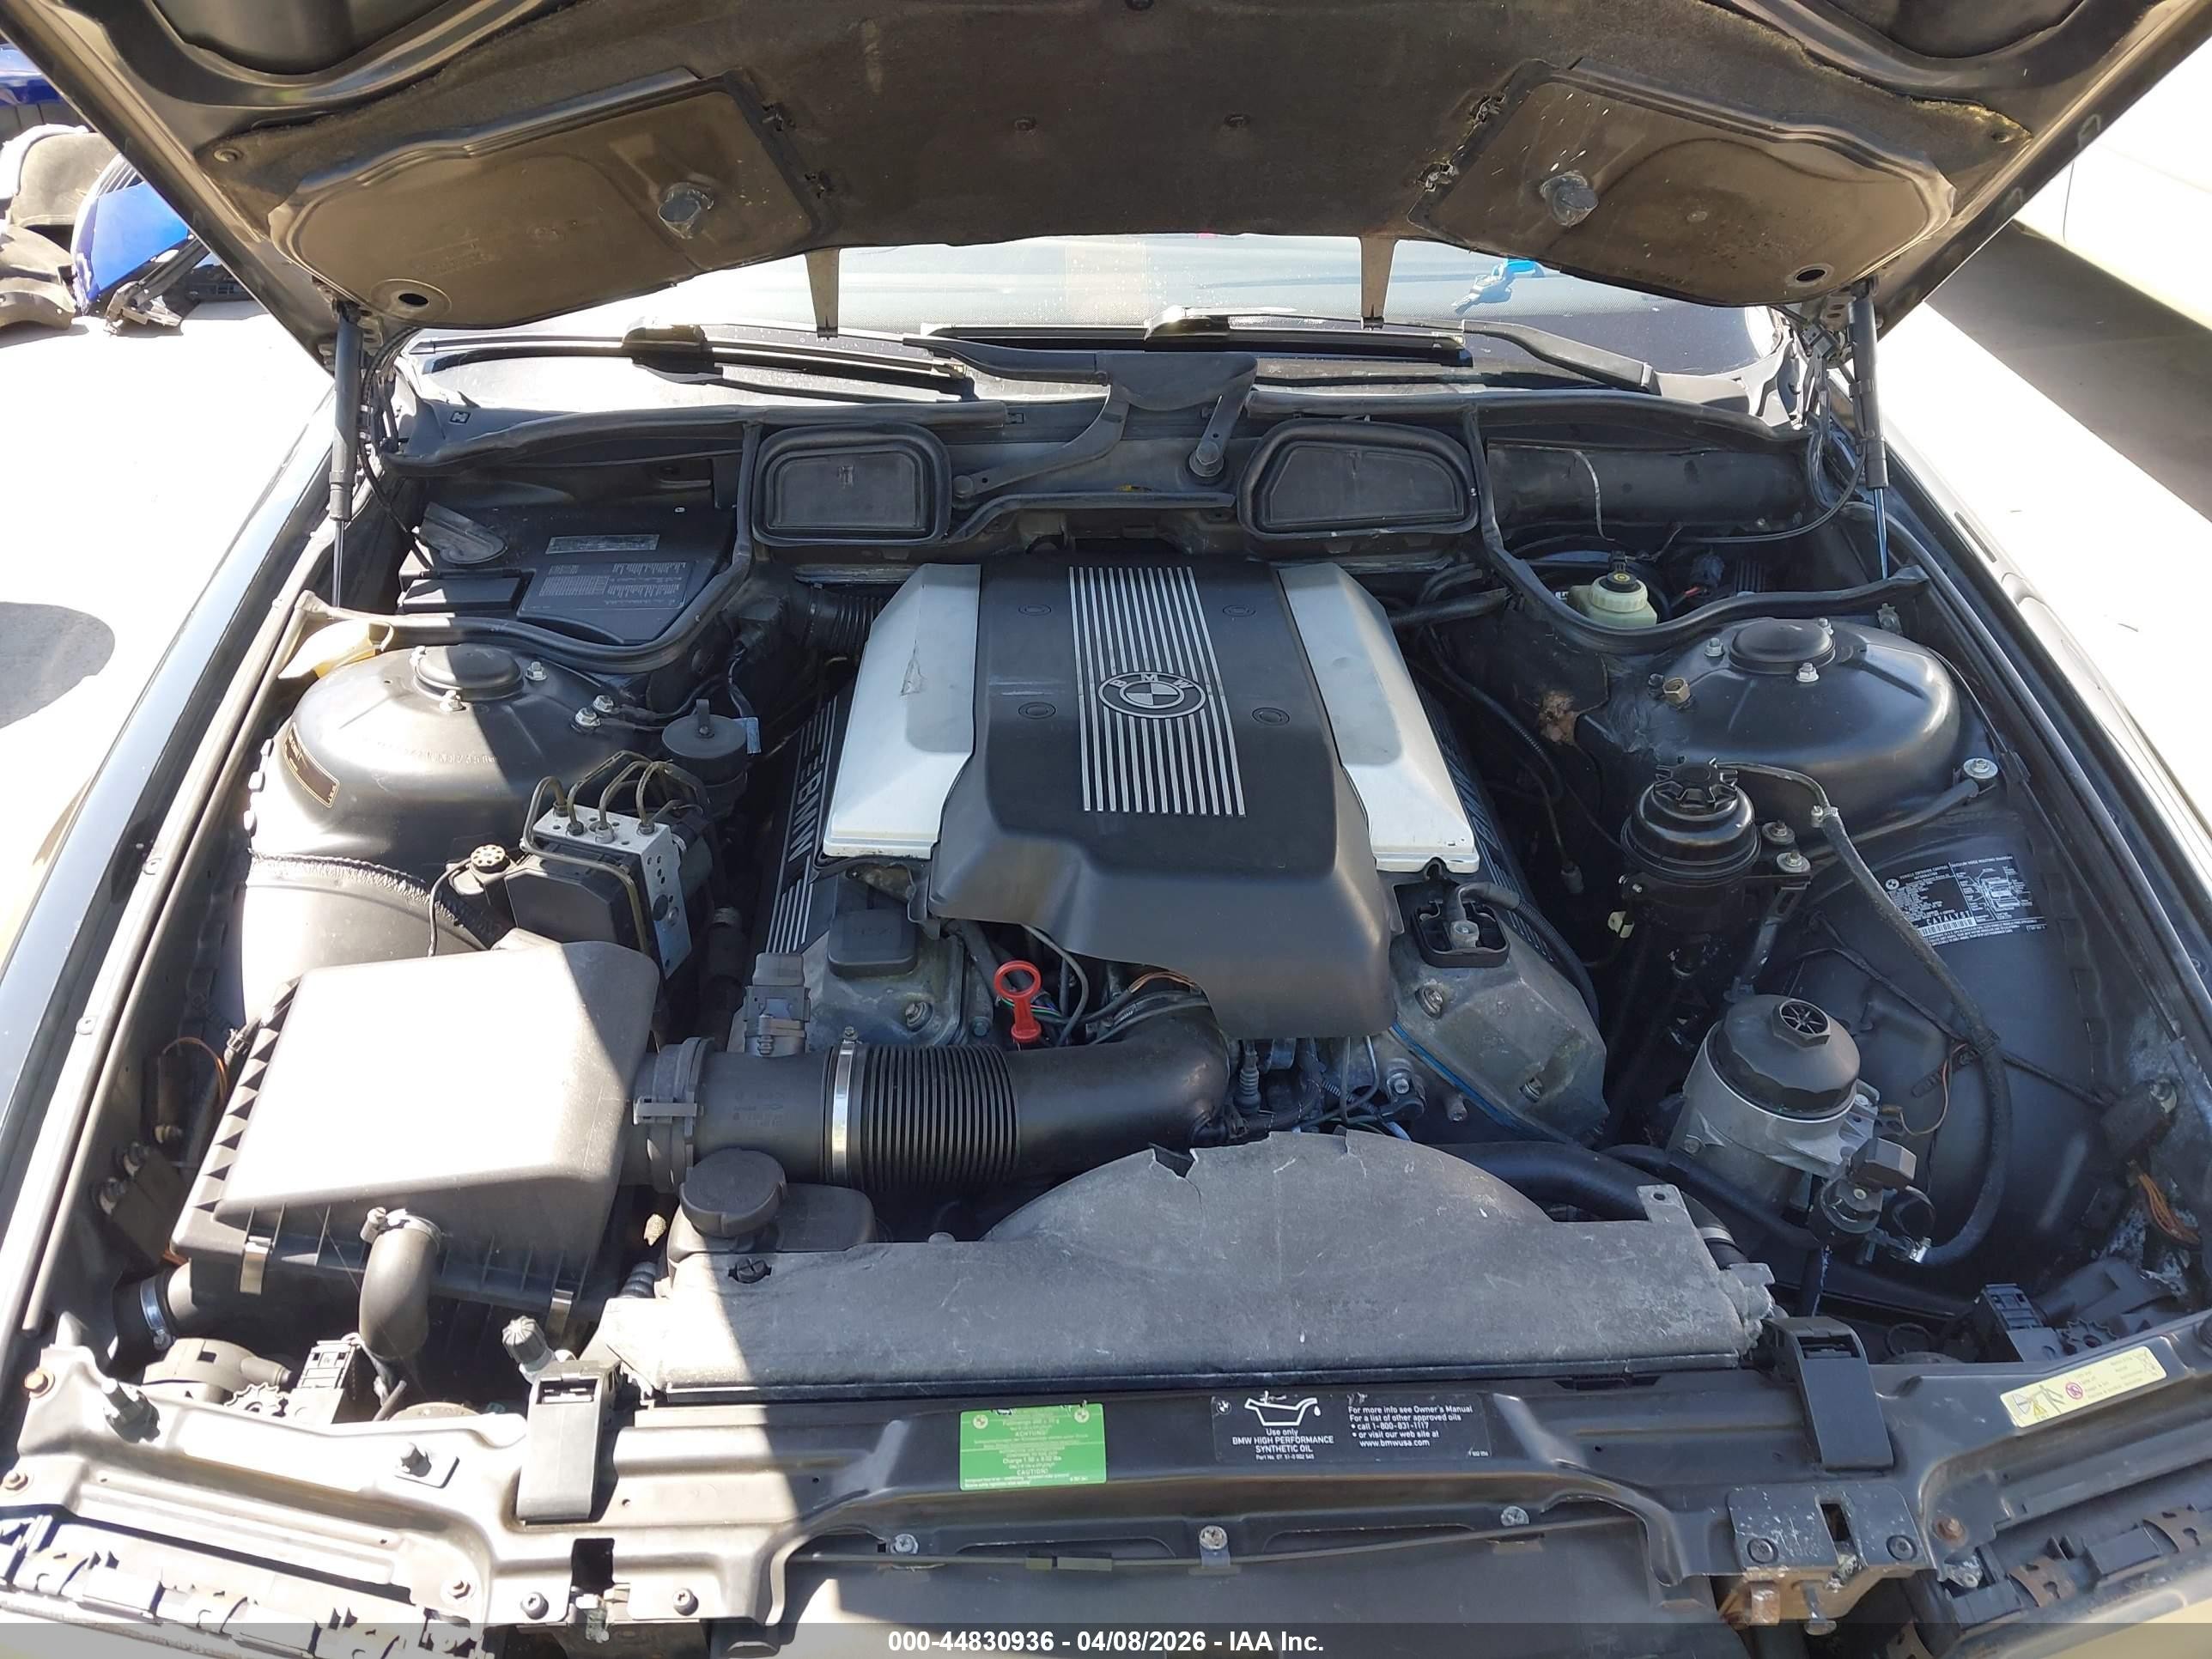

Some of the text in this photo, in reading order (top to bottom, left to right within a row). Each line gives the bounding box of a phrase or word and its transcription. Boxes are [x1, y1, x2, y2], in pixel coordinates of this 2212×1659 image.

[1109, 673, 1194, 690] BMW
[787, 769, 823, 863] BMW
[1926, 910, 1972, 926] CATALYST
[1383, 1405, 1398, 1413] info
[1413, 1405, 1444, 1413] Owner's
[1445, 1404, 1474, 1413] Manual
[1370, 1413, 1382, 1422] list
[1383, 1413, 1391, 1422] of
[1392, 1413, 1411, 1422] other
[1413, 1413, 1448, 1422] approved
[1372, 1421, 1430, 1430] 1-800-831-1117
[1282, 1427, 1299, 1437] only
[1368, 1430, 1384, 1438] visit
[1399, 1430, 1416, 1438] web
[1417, 1430, 1431, 1438] site
[1254, 1436, 1273, 1444] HIGH
[1275, 1436, 1334, 1444] PERFORMANCE
[1359, 1438, 1431, 1448] www.bmwusa.com
[1255, 1444, 1314, 1453] SYNTHETIC OIL
